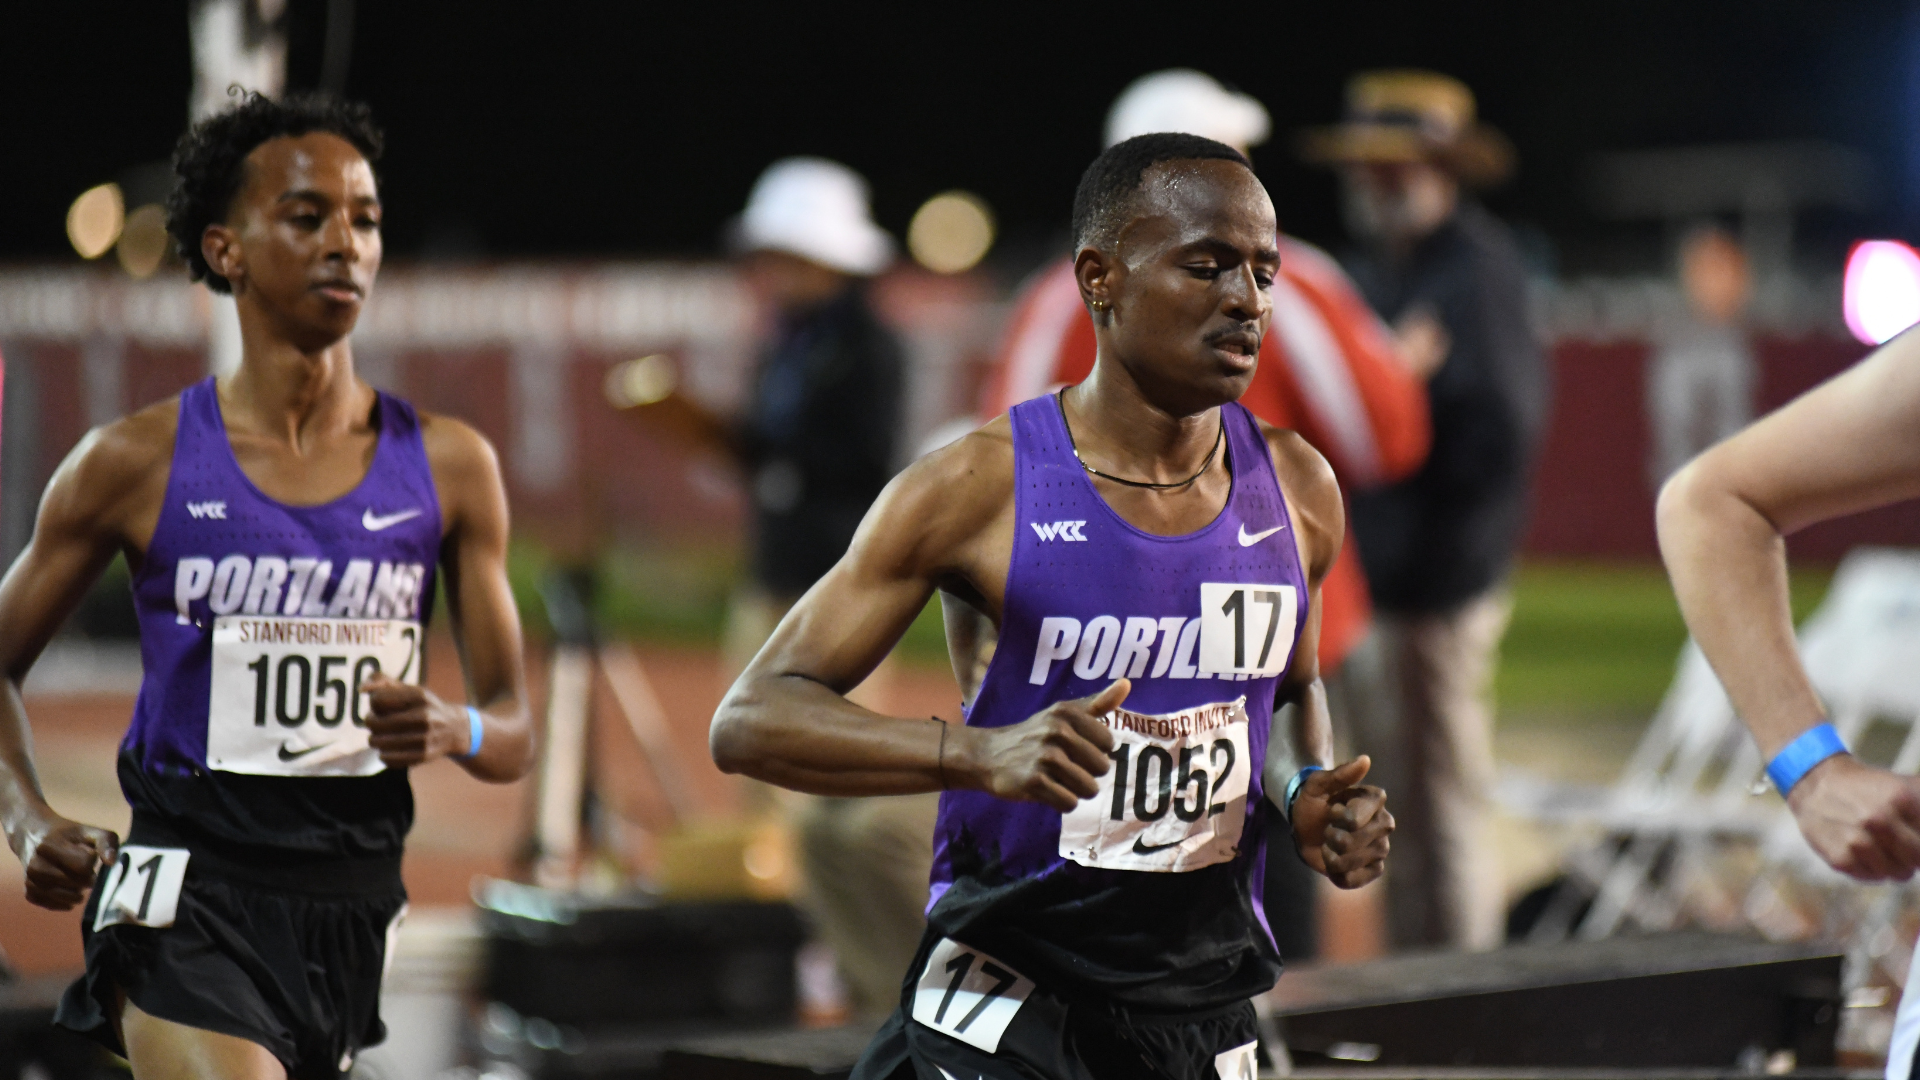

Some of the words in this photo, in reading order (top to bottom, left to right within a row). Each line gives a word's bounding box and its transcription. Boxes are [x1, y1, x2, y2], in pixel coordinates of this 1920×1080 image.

[1030, 521, 1088, 542] WCC
[240, 621, 331, 644] STANFORD
[336, 623, 386, 646] INVITE
[1029, 615, 1283, 686] PORTL
[1221, 590, 1282, 669] 17
[1111, 738, 1236, 822] 1052
[936, 952, 1018, 1034] 17
